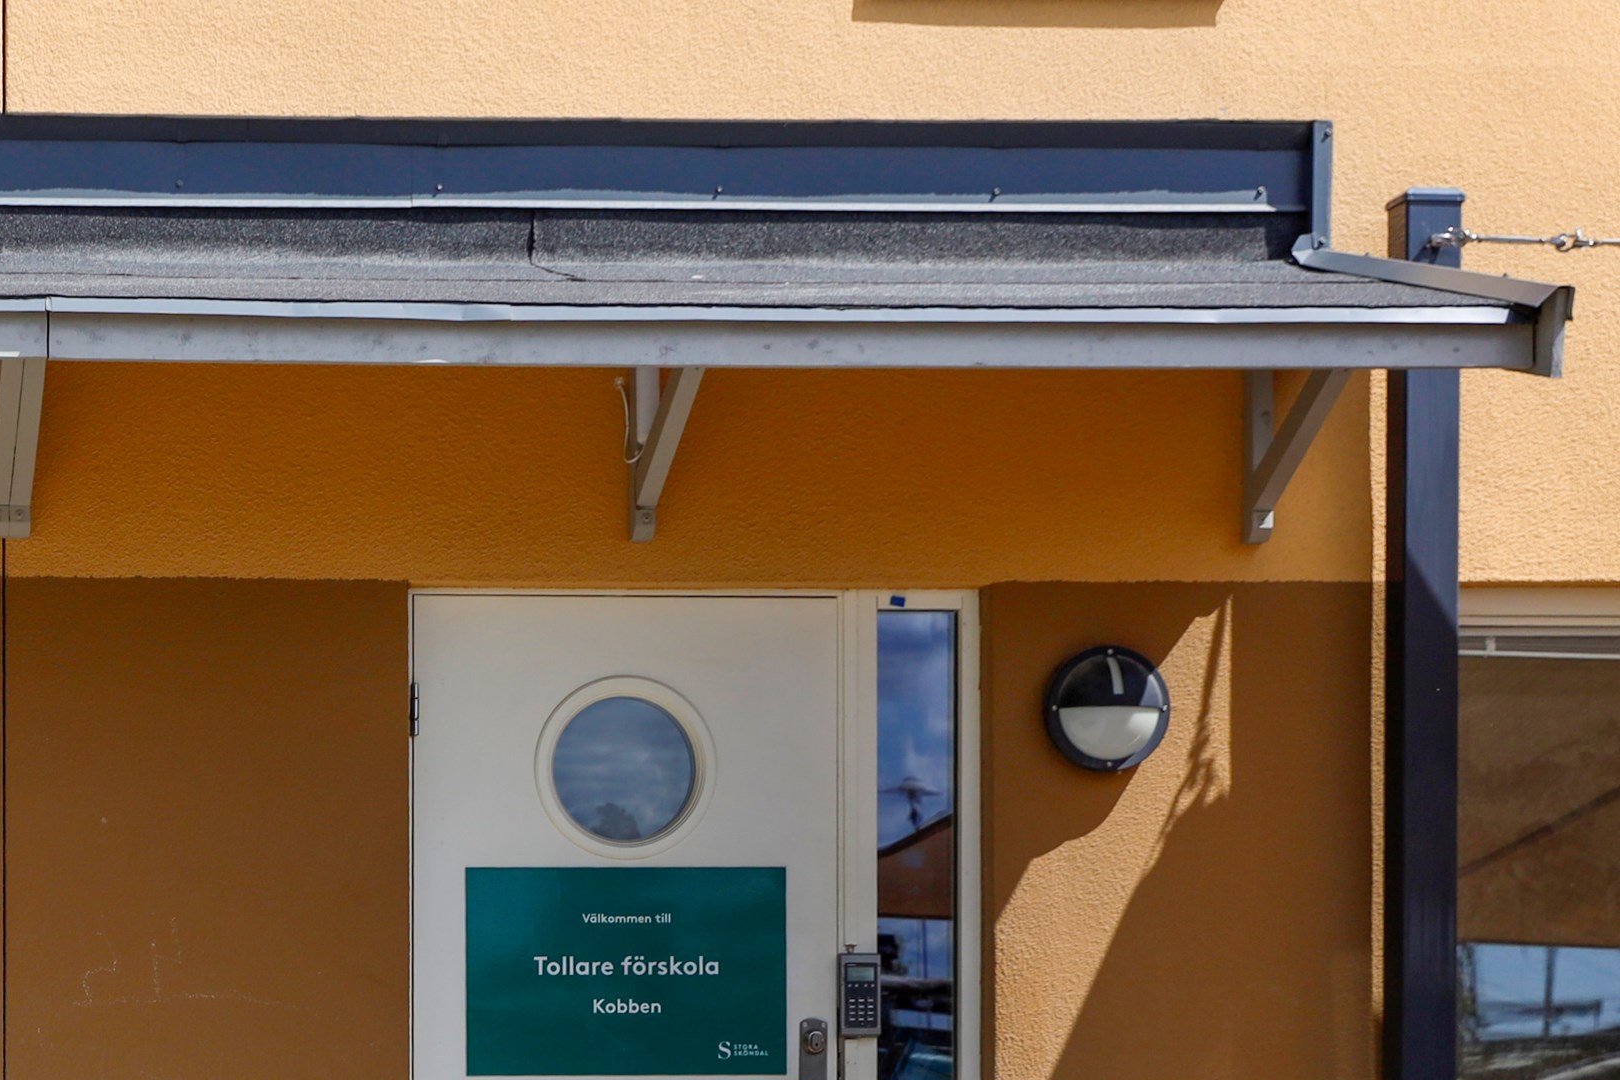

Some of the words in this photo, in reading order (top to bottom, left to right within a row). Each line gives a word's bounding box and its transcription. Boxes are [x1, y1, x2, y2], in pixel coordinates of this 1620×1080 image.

[582, 912, 652, 924] Välkommen
[654, 912, 672, 924] till
[532, 955, 615, 976] Tollare
[620, 955, 720, 976] förskola
[592, 998, 662, 1014] Kobben
